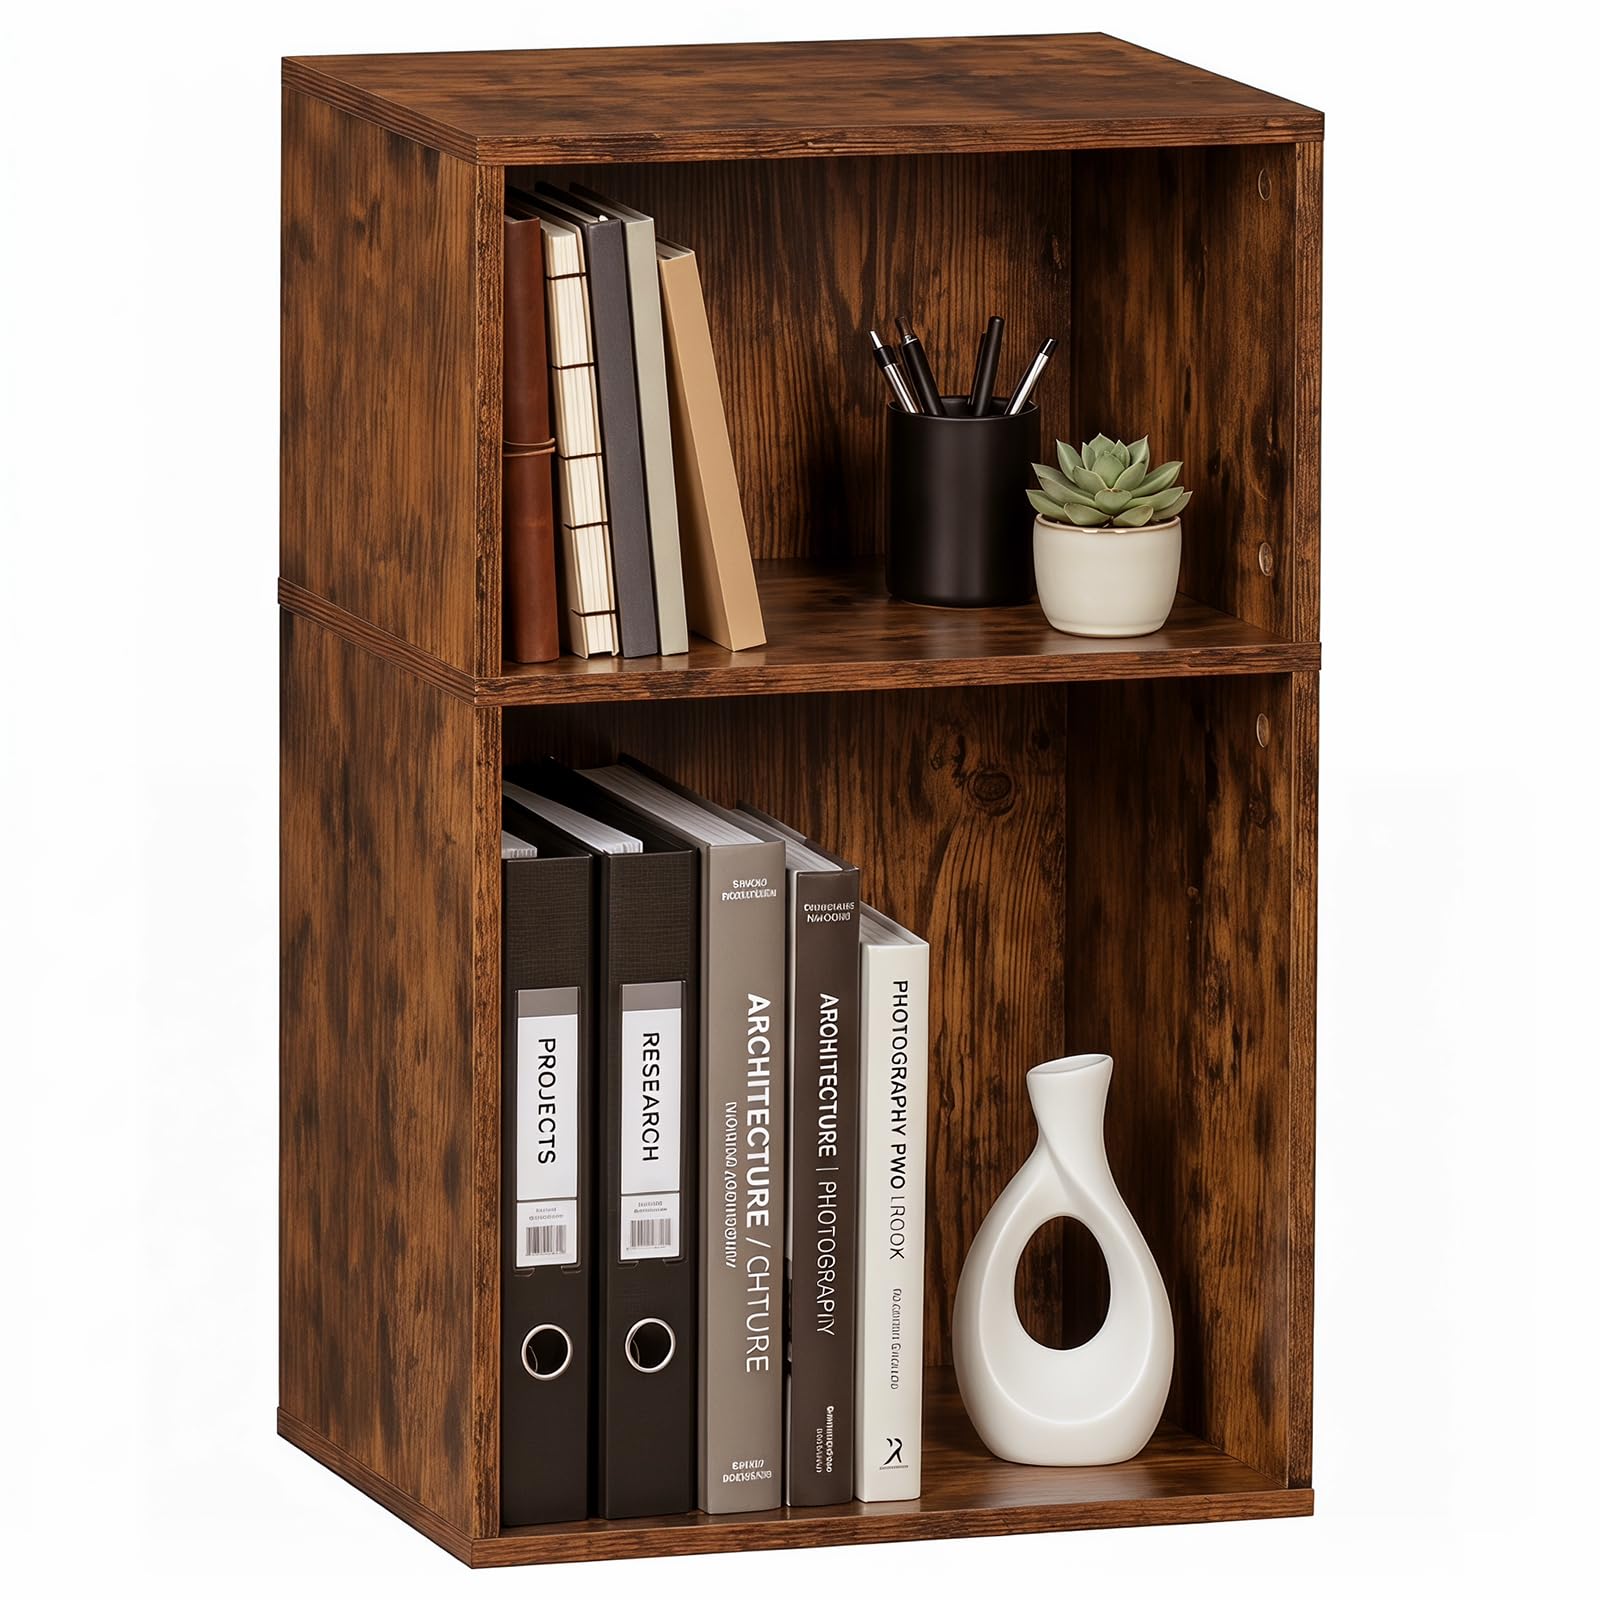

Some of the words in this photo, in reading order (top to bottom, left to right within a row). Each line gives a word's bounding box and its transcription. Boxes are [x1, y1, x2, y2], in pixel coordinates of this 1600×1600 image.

[537, 1038, 557, 1164] PROJECTS
[641, 1032, 660, 1162] RESEARCH
[746, 993, 771, 1229] ARCHITECTURE
[890, 980, 909, 1137] PHOTOGRAPHY
[890, 1143, 907, 1190] PWO
[746, 1255, 770, 1373] CHTURE
